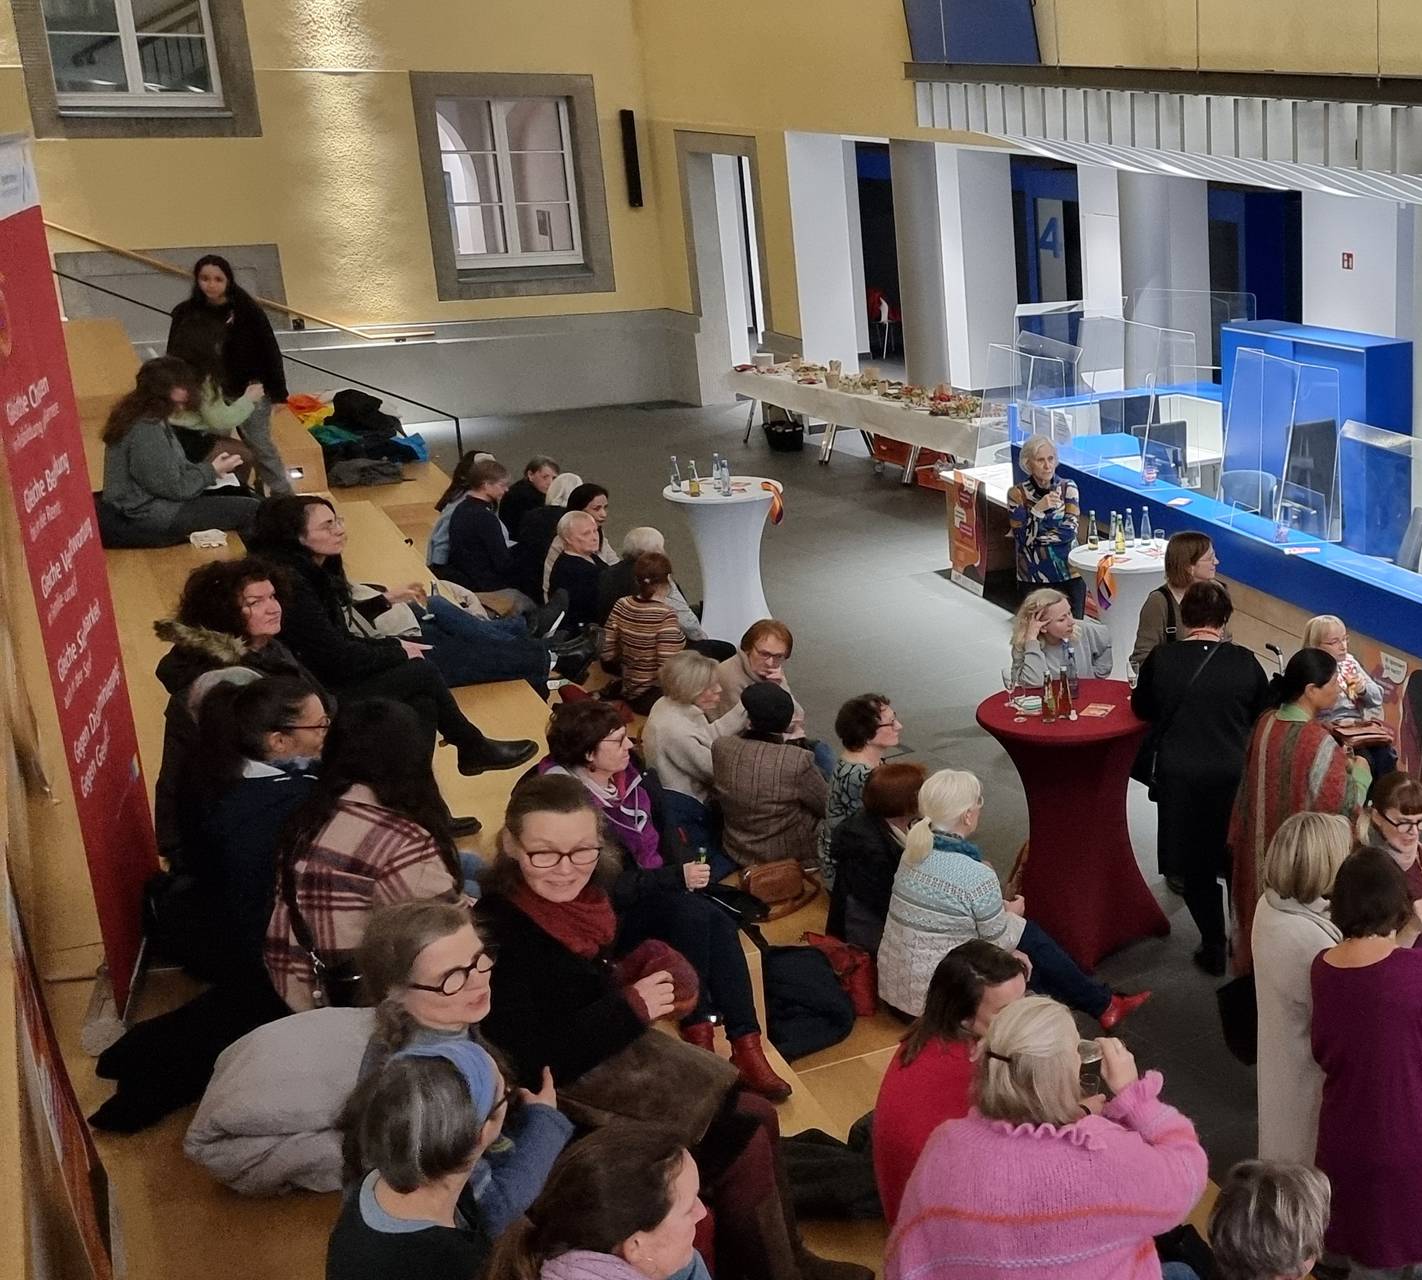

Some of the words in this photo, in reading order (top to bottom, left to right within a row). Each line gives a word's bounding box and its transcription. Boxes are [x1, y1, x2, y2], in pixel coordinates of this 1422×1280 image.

[1040, 216, 1062, 258] 4
[41, 561, 62, 599] Gleiche
[57, 642, 78, 682] Gleiche
[73, 725, 90, 764] Gegen
[80, 759, 97, 798] Gegen
